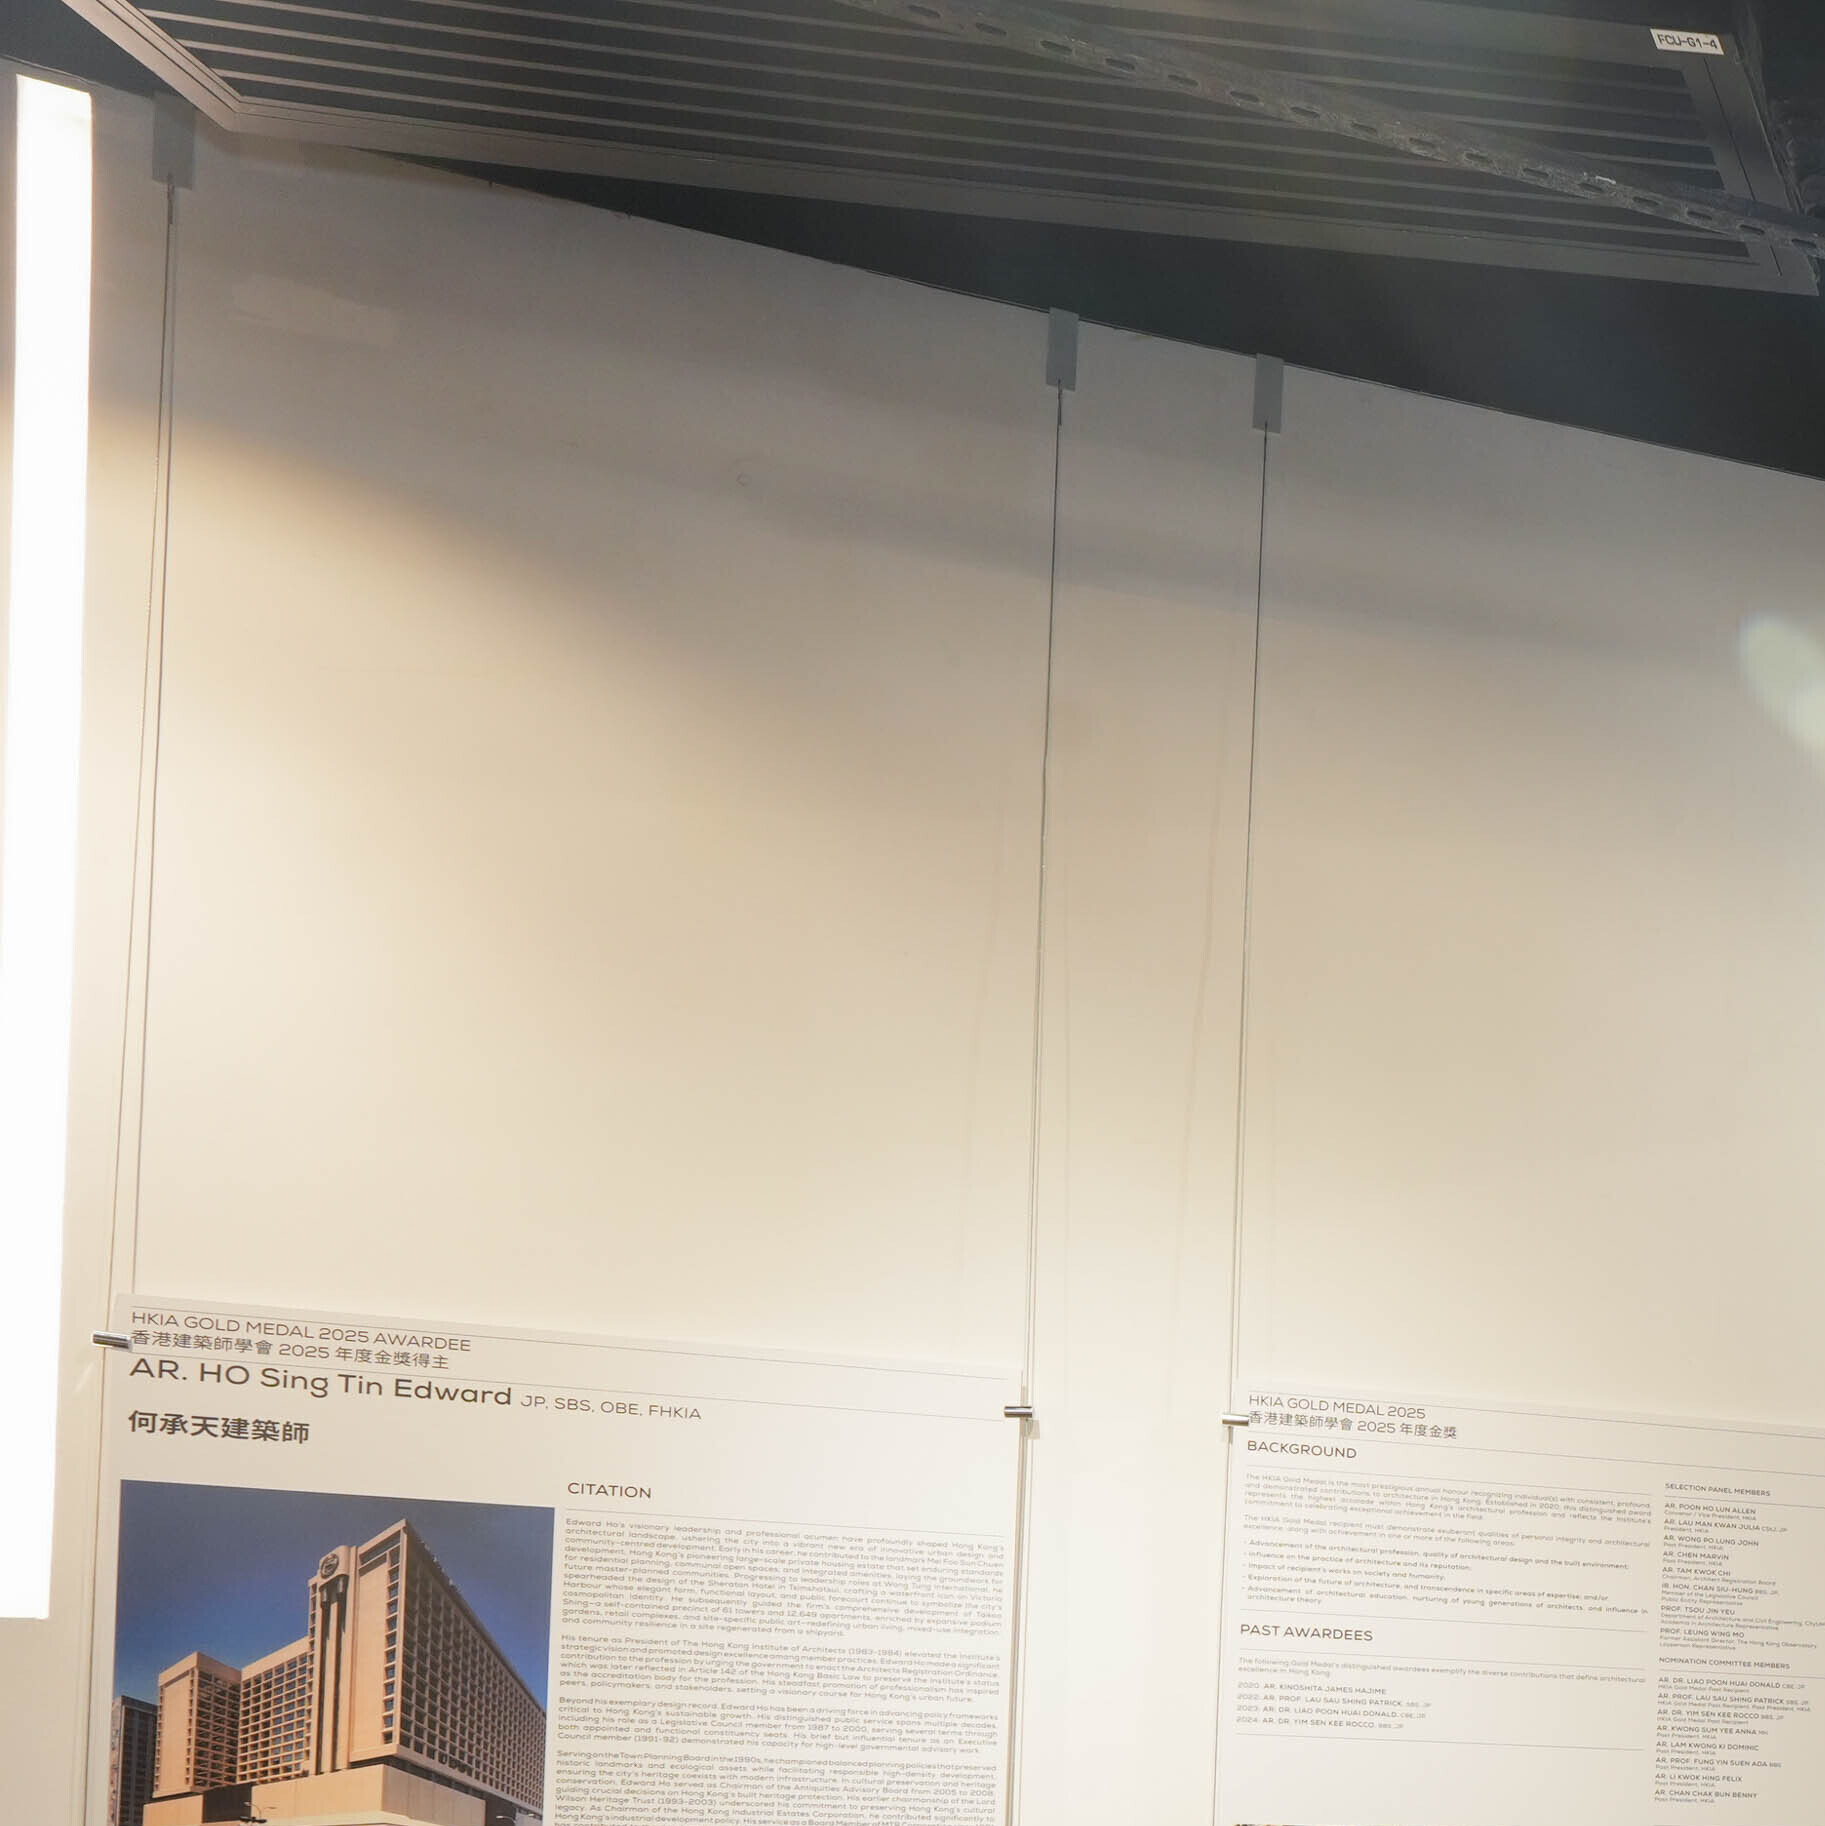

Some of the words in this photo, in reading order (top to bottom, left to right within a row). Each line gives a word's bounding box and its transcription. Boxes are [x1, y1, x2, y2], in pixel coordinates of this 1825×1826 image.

[1657, 34, 1718, 49] FCU-G1-4
[132, 1311, 179, 1327] HKIA
[183, 1315, 240, 1331] GOLD
[246, 1321, 314, 1338] MEDAL
[318, 1327, 369, 1343] 2025
[373, 1332, 470, 1351] AWARDEE
[132, 1329, 272, 1355] 香港建築師學會
[278, 1343, 329, 1358] 2025
[335, 1346, 448, 1369] 年度金獎得主
[130, 1357, 186, 1380] AR.
[199, 1362, 249, 1384] HO
[260, 1367, 328, 1398] Sing
[337, 1373, 382, 1395] Tin
[394, 1378, 511, 1405] Edward
[648, 1404, 701, 1419] FHKIA
[1249, 1394, 1283, 1407] HKIA
[1287, 1397, 1329, 1411] GOLD
[1332, 1401, 1384, 1416] MEDAL
[1387, 1405, 1425, 1419] 2025
[128, 1409, 309, 1444] 何承天建築師
[1249, 1410, 1352, 1430] 香港建築師學會
[1357, 1420, 1395, 1433] 2025
[1399, 1422, 1456, 1439] 年度金獎
[1247, 1439, 1356, 1458] BACKGROUND
[567, 1482, 650, 1498] CITATION
[1665, 1483, 1706, 1491] SELECTION
[1707, 1485, 1732, 1493] PANEL
[1733, 1487, 1770, 1496] MEMBERS
[1240, 1623, 1280, 1636] PAST
[1283, 1626, 1372, 1641] AWARDEES
[1659, 1656, 1706, 1664] NOMINATION
[1708, 1659, 1751, 1667] COMMITTEE
[1753, 1661, 1790, 1669] MEMBERS
